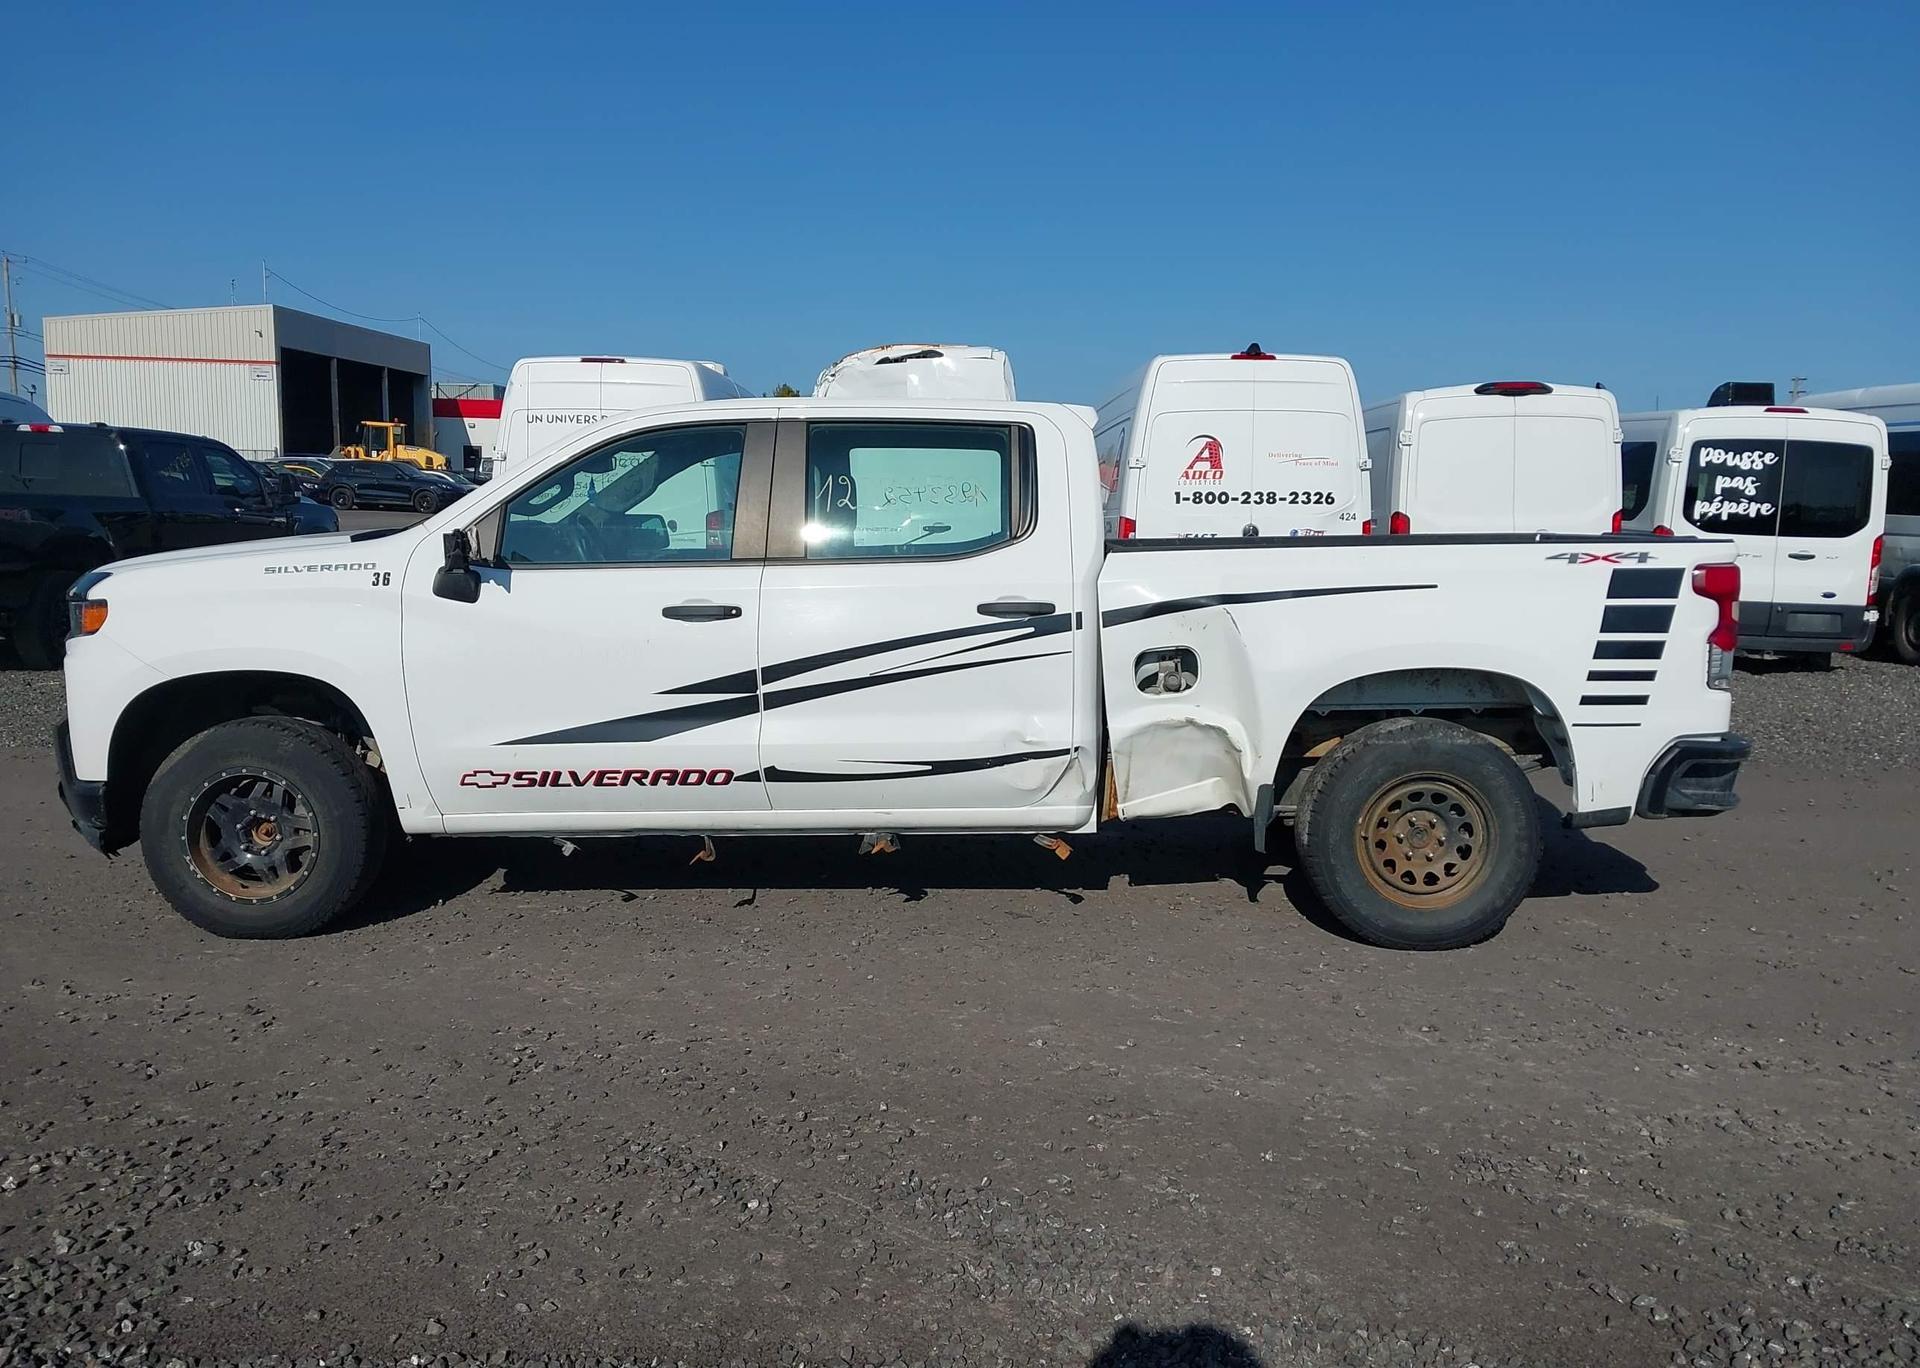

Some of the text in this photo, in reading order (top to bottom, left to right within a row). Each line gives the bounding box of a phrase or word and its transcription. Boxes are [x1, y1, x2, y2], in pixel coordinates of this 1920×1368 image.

[526, 414, 543, 424] UN
[1180, 469, 1224, 480] ADCO
[1714, 475, 1761, 495] pas
[1174, 491, 1336, 505] 1-800-238-2326
[1693, 496, 1776, 521] pépère
[1338, 512, 1357, 521] 424
[263, 562, 377, 575] SILVERADO
[371, 571, 392, 587] 36
[511, 768, 735, 788] SILVERADO
